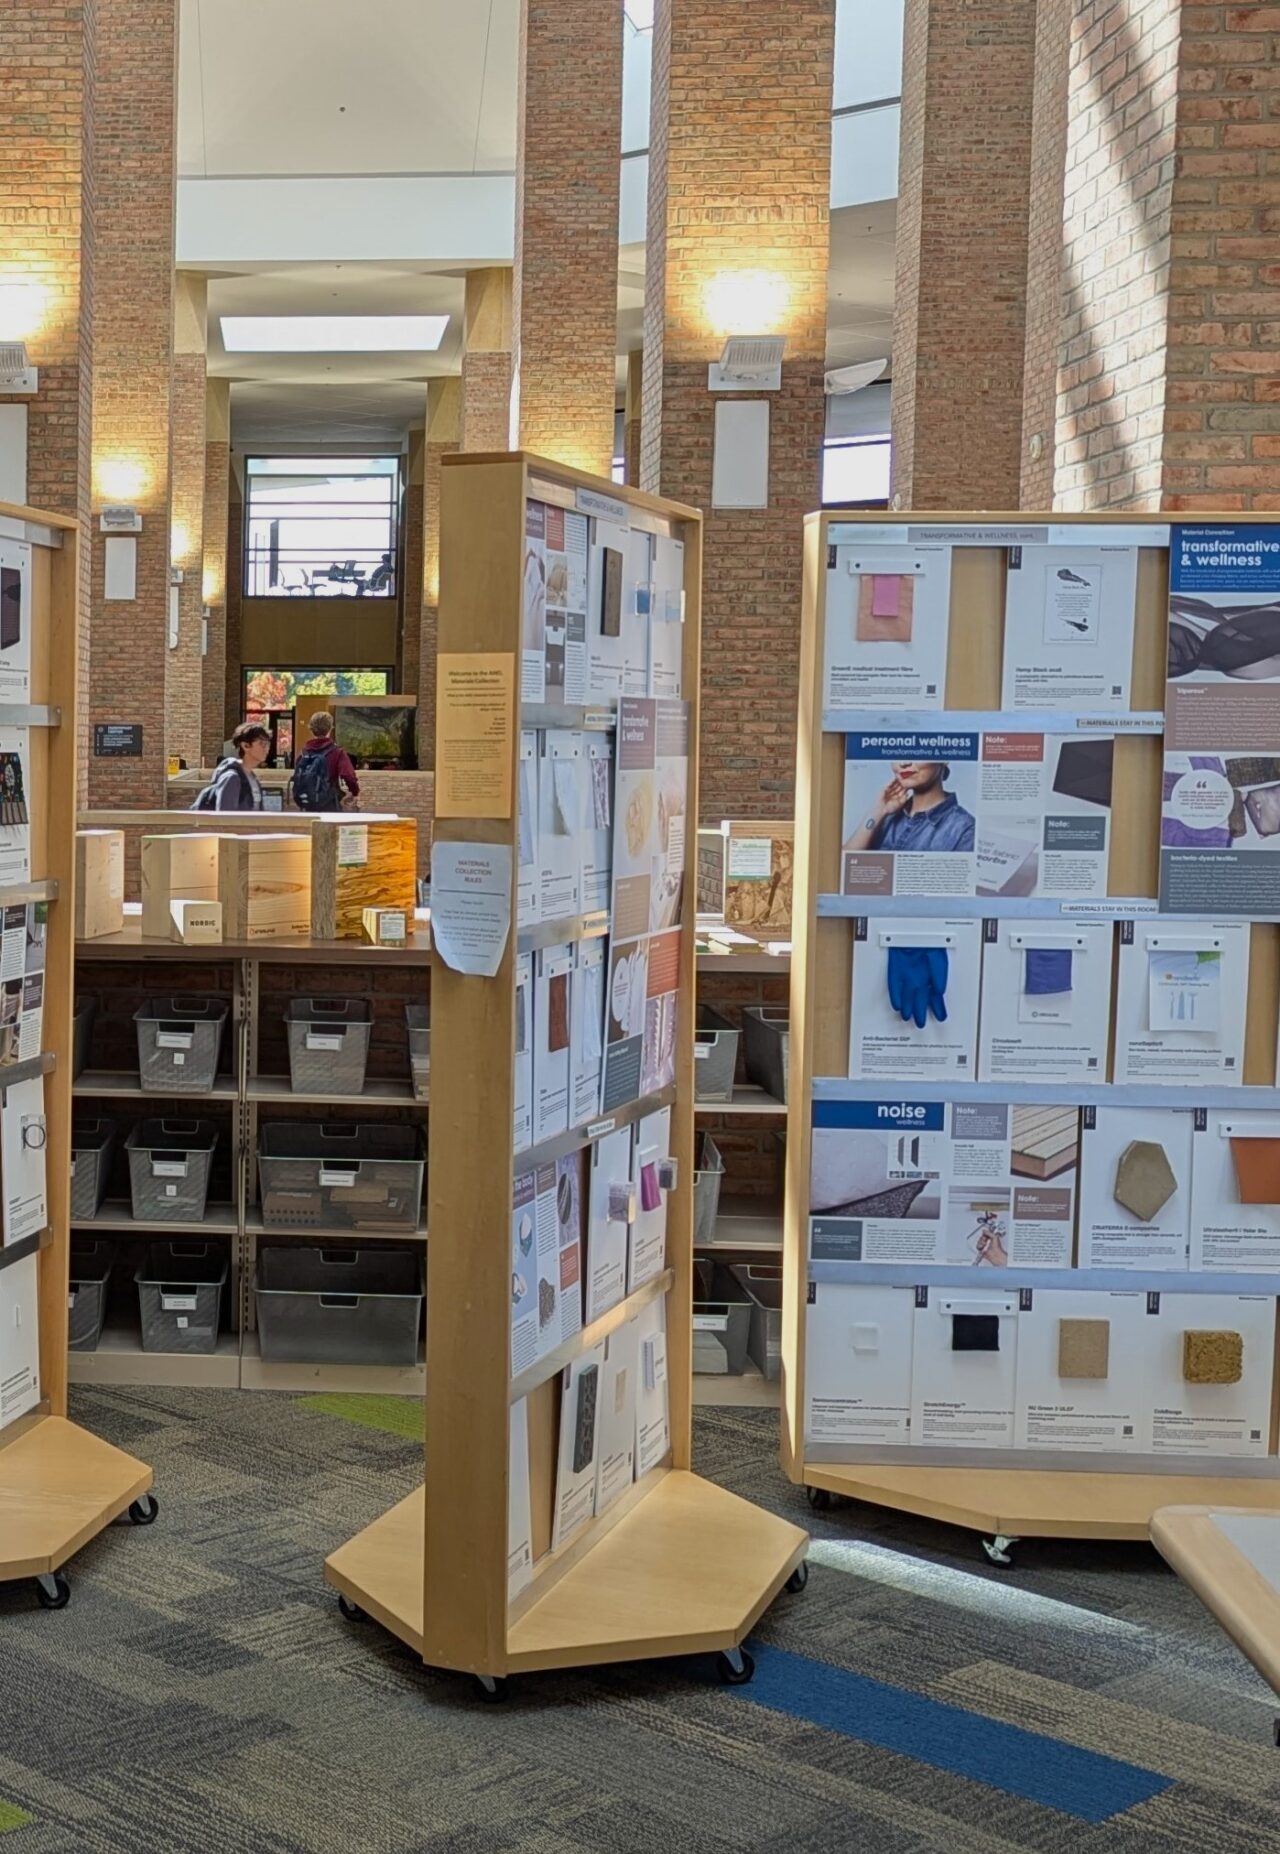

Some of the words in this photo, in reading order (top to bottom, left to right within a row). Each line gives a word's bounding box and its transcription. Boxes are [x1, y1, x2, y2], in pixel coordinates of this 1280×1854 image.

[1181, 540, 1280, 553] transformative
[1181, 554, 1191, 566] &
[1196, 553, 1262, 566] wellness
[861, 735, 916, 748] personal
[919, 735, 971, 747] wellness
[985, 736, 1007, 744] Note:
[881, 748, 933, 756] transformative
[942, 748, 971, 756] wellness
[1048, 820, 1070, 828] Note:
[1170, 855, 1215, 863] bacteria-dyed
[455, 868, 492, 876] COLLECTION
[464, 876, 482, 884] RULES
[877, 1102, 926, 1119] noise
[956, 1106, 978, 1115] Note:
[1017, 1194, 1040, 1203] Note:
